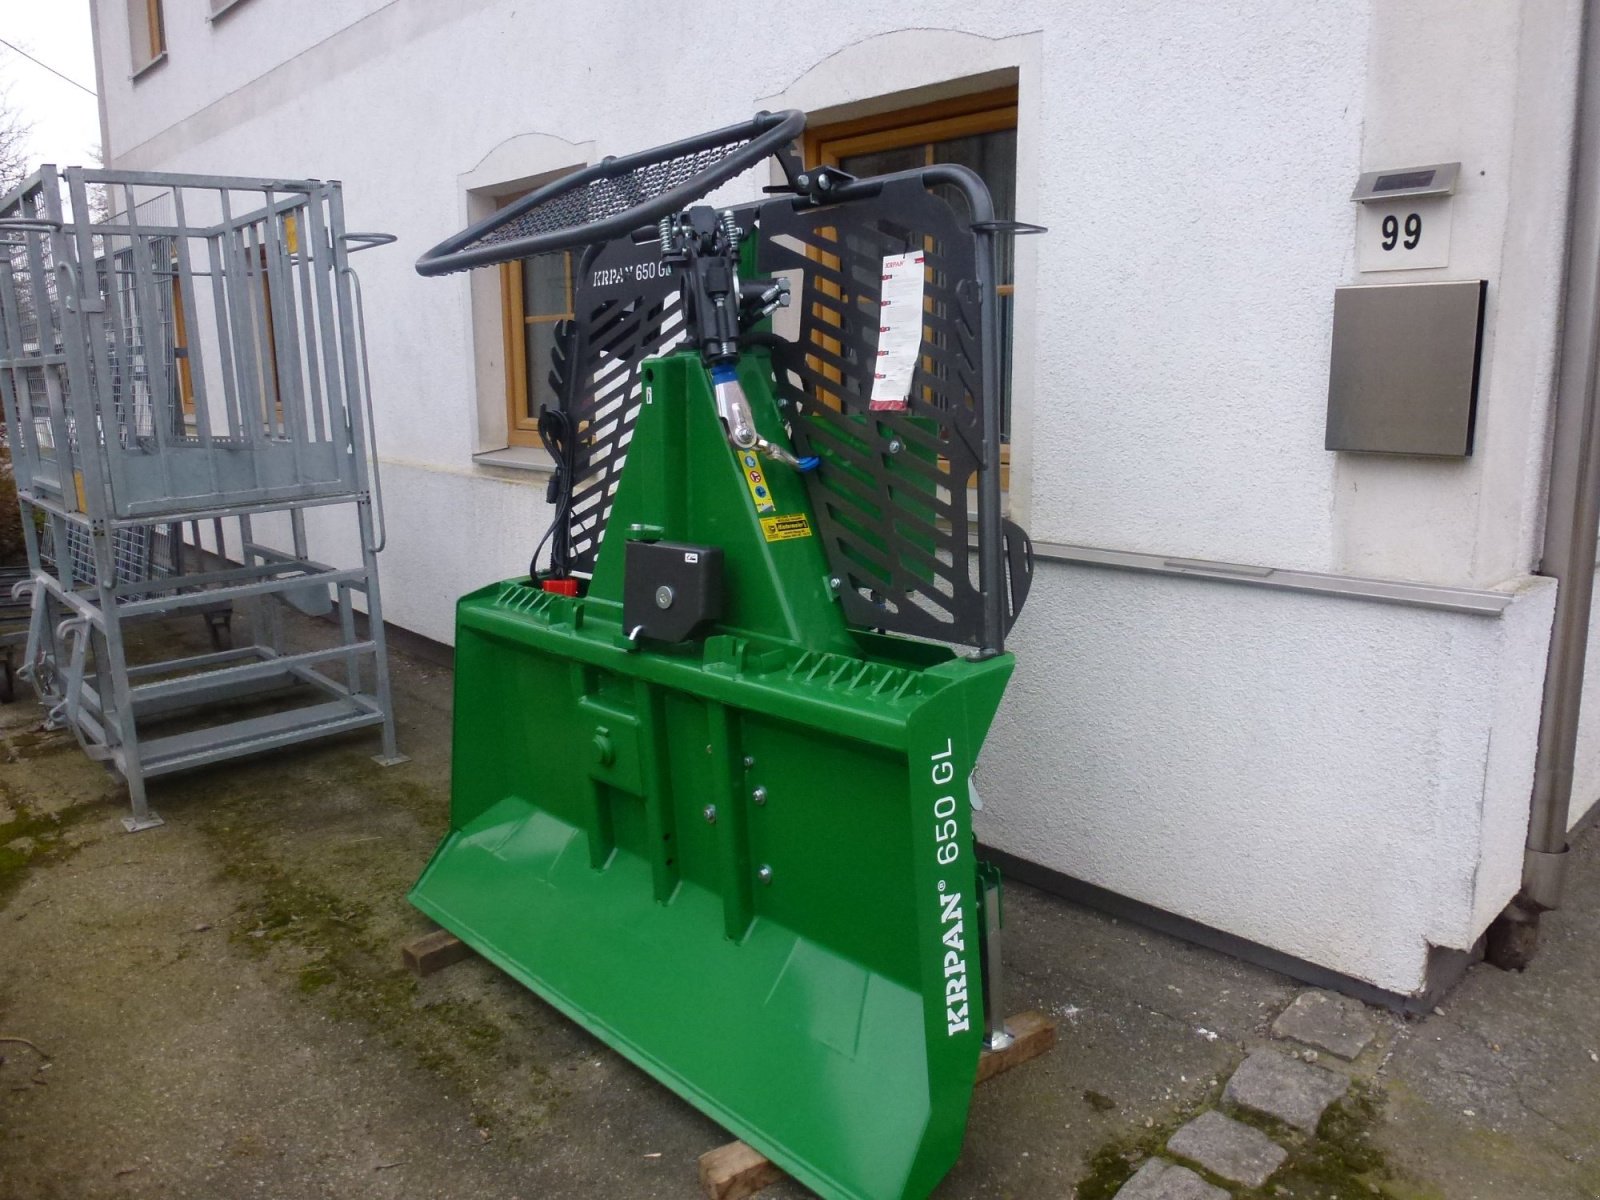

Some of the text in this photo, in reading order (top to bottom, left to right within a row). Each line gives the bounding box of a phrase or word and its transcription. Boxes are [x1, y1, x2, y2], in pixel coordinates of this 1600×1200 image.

[1382, 213, 1422, 251] 99
[635, 262, 656, 281] 650
[931, 738, 954, 785] GL
[934, 795, 958, 865] 650
